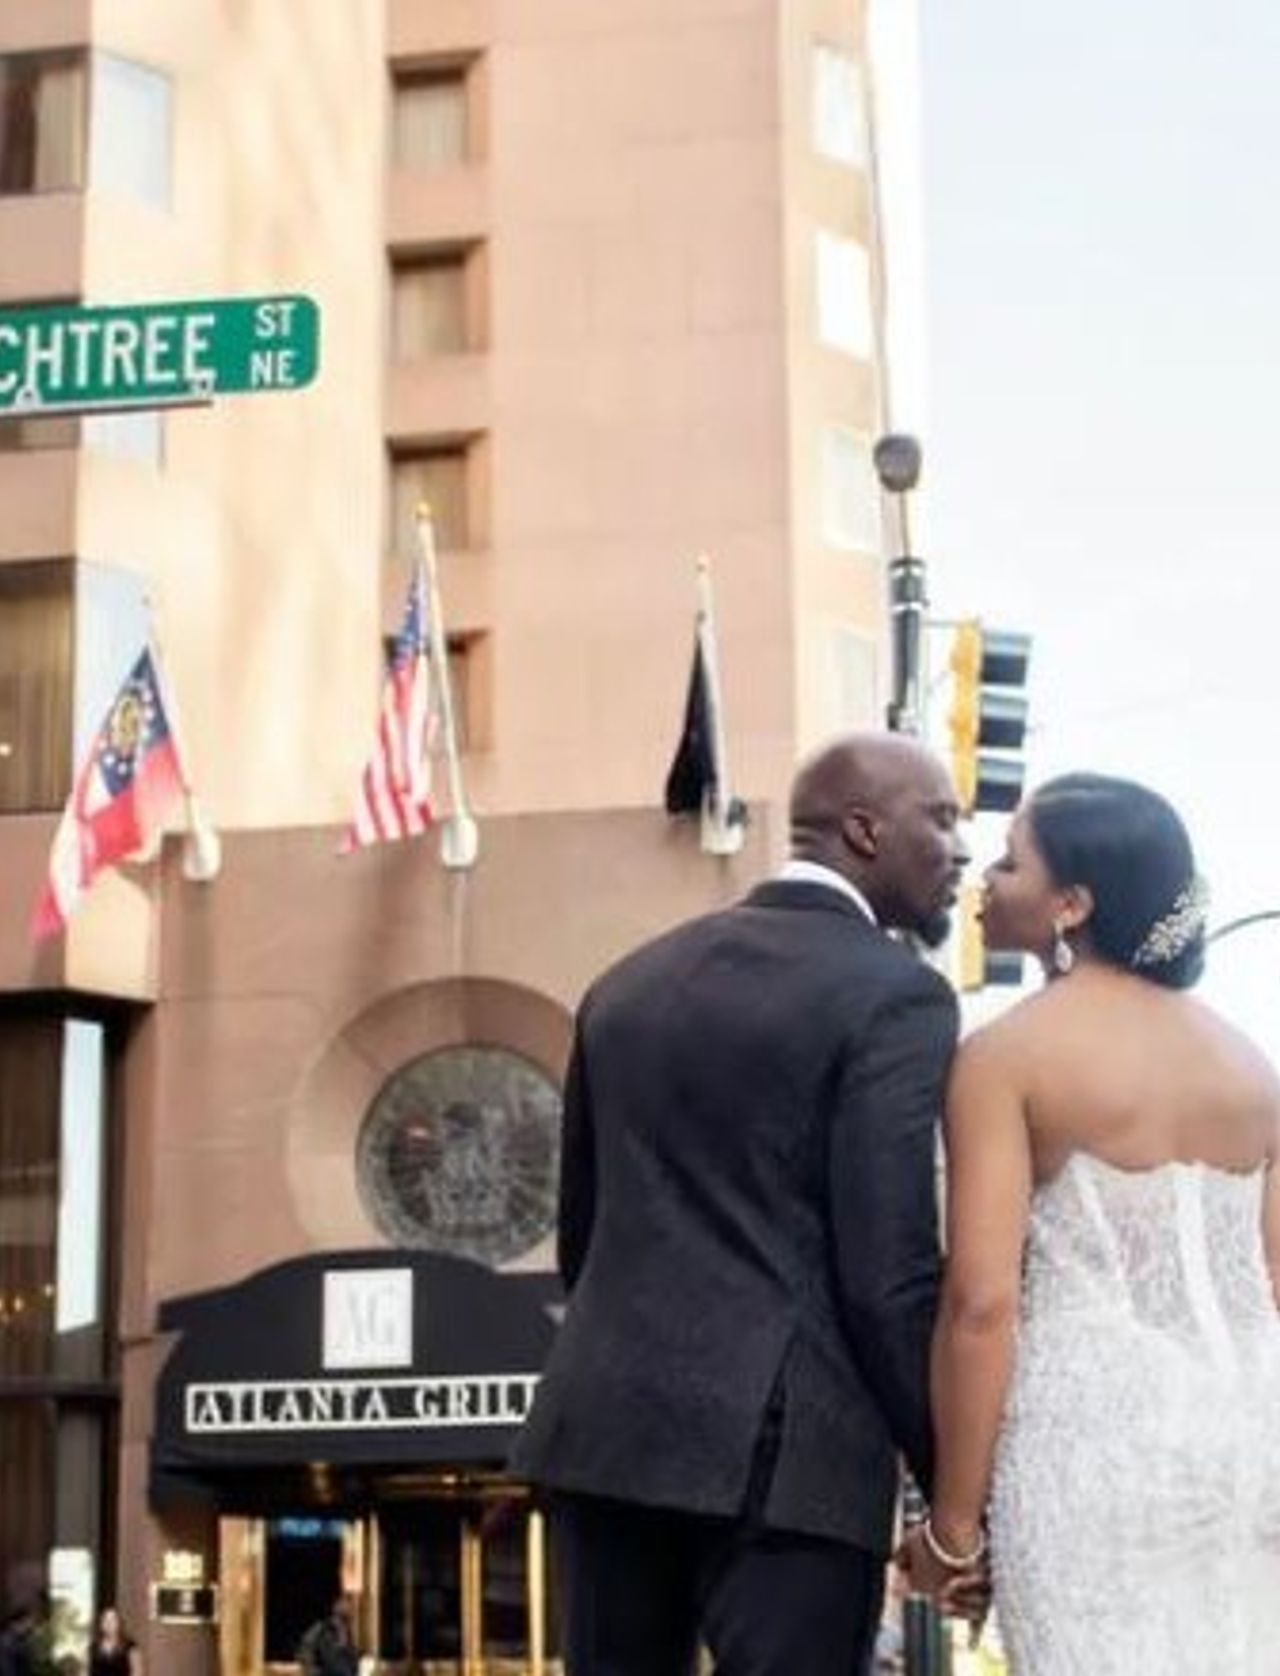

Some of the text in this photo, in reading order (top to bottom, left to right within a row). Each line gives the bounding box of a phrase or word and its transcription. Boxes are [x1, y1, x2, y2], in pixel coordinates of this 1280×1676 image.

[254, 302, 296, 338] ST
[250, 350, 296, 386] NE
[196, 1386, 389, 1424] ATLANTA
